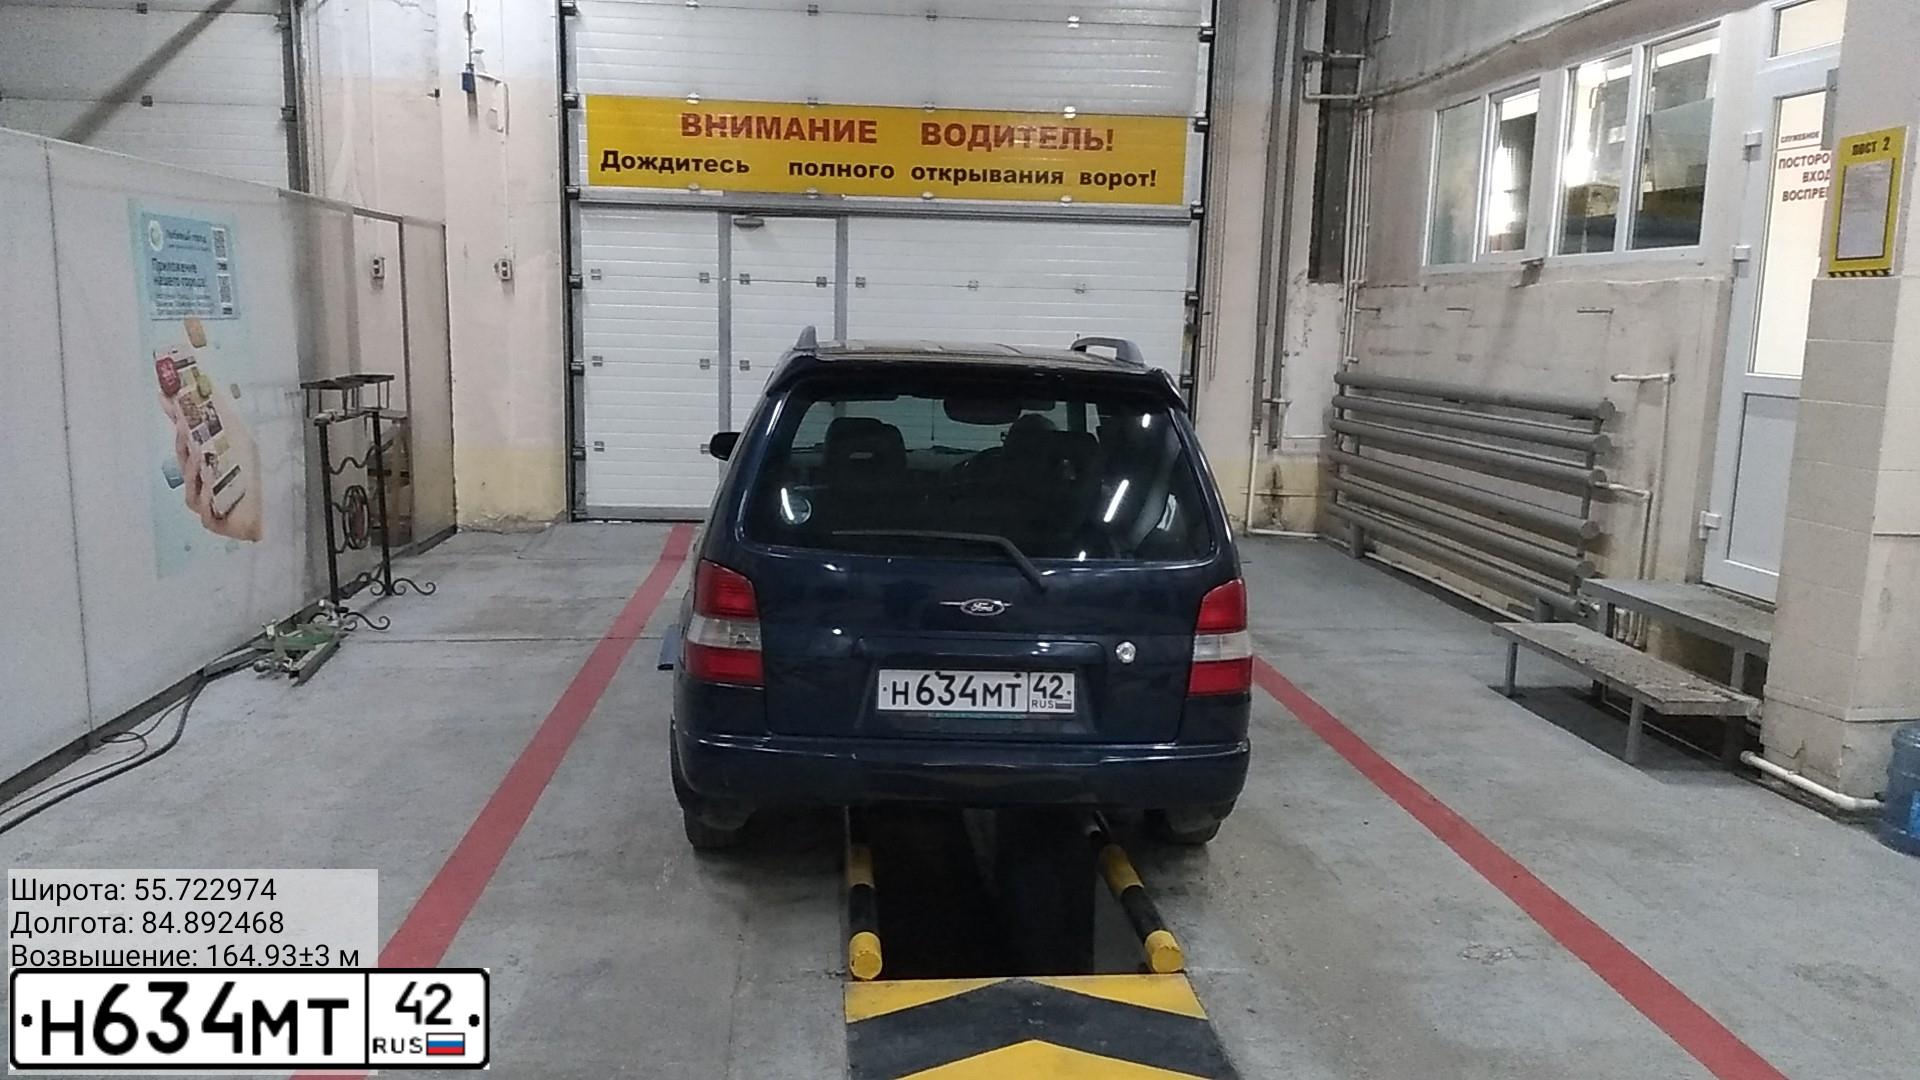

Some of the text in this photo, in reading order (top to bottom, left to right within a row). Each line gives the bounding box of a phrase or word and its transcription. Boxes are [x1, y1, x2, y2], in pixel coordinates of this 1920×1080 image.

[681, 112, 1114, 152] ВНИМАНИЕ ВОДИТЕЛЬ!
[1780, 131, 1820, 144] СЛУЖЕБНОЕ
[1852, 136, 1891, 156] ПОСТ 2
[600, 150, 1157, 190] Дождитесь полного открывания ворот!
[1782, 186, 1828, 202] ВОСПРЕ
[970, 601, 995, 613] Ford
[1032, 674, 1065, 700] 42
[1031, 699, 1055, 709] RUS
